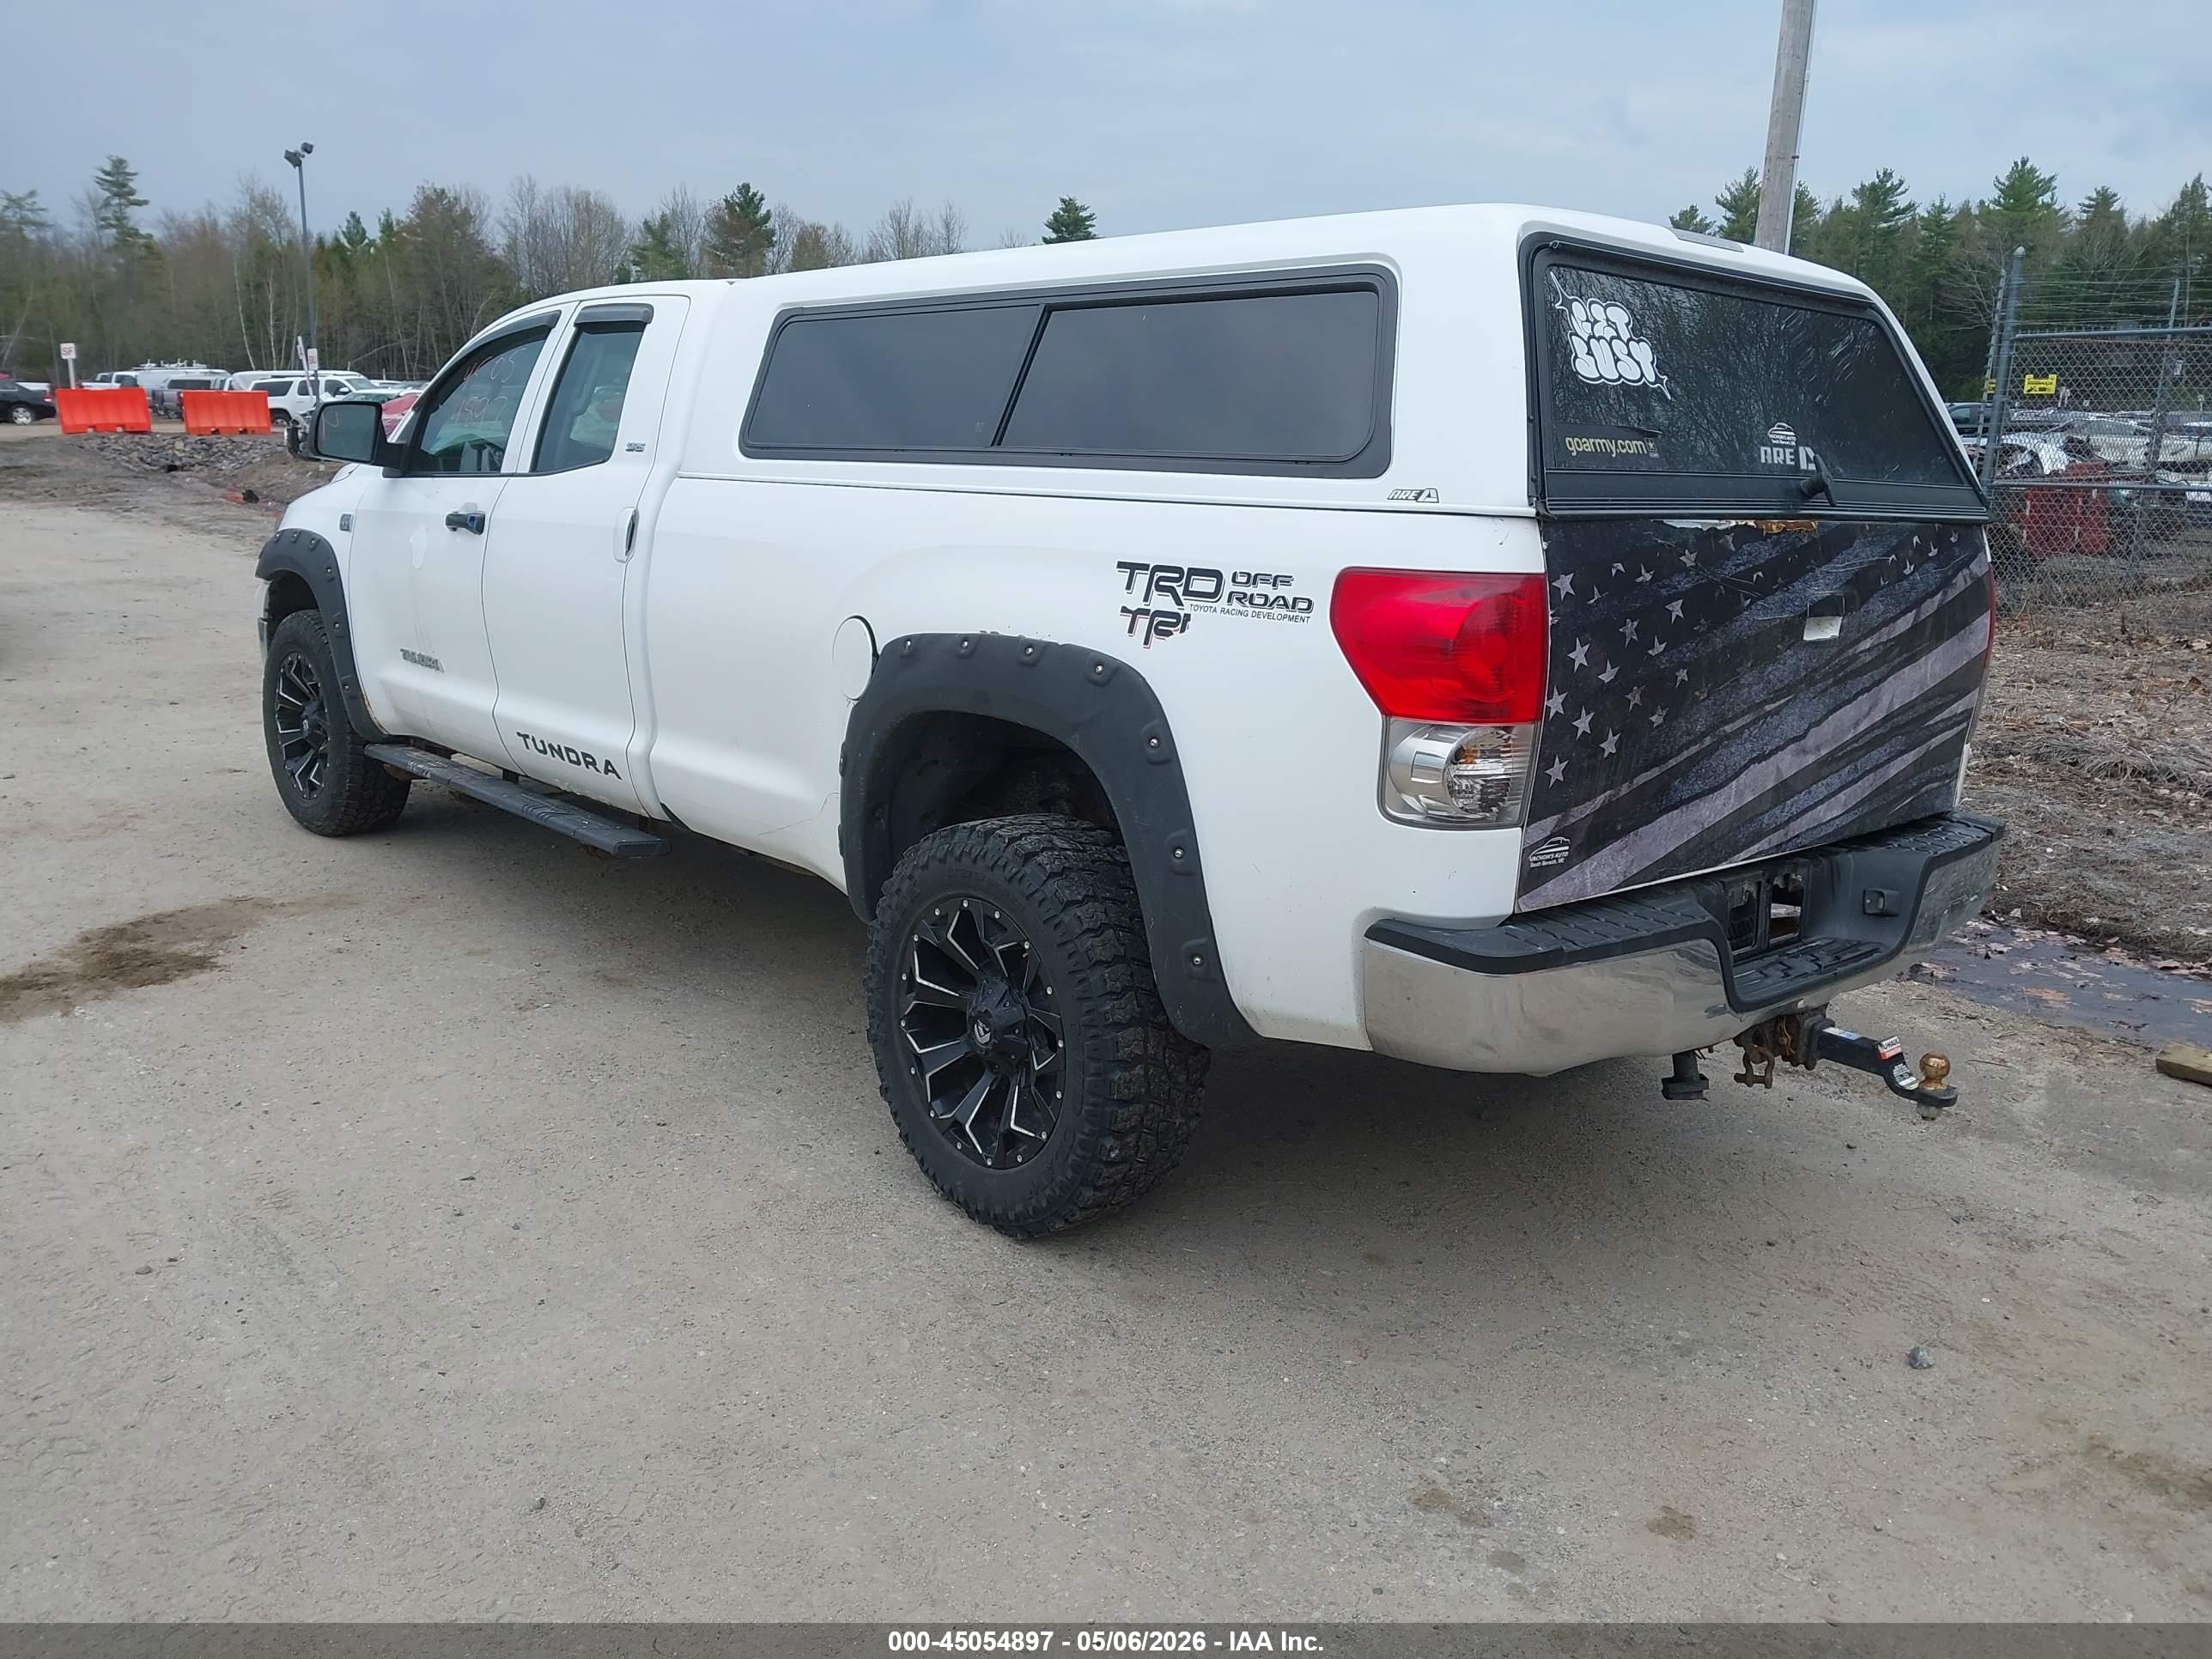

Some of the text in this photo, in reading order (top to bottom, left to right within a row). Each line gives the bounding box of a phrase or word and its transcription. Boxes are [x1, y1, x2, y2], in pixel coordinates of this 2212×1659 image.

[1570, 299, 1631, 343] GET
[1570, 336, 1656, 383] BUSY
[1565, 437, 1648, 457] goarmy.com
[1116, 561, 1225, 611] TRD
[1231, 571, 1294, 590] OFF
[1189, 604, 1311, 623] TOYOTA RACING DEVELOPMENT
[1226, 591, 1314, 613] ROAD
[515, 732, 623, 780] TUNDRA
